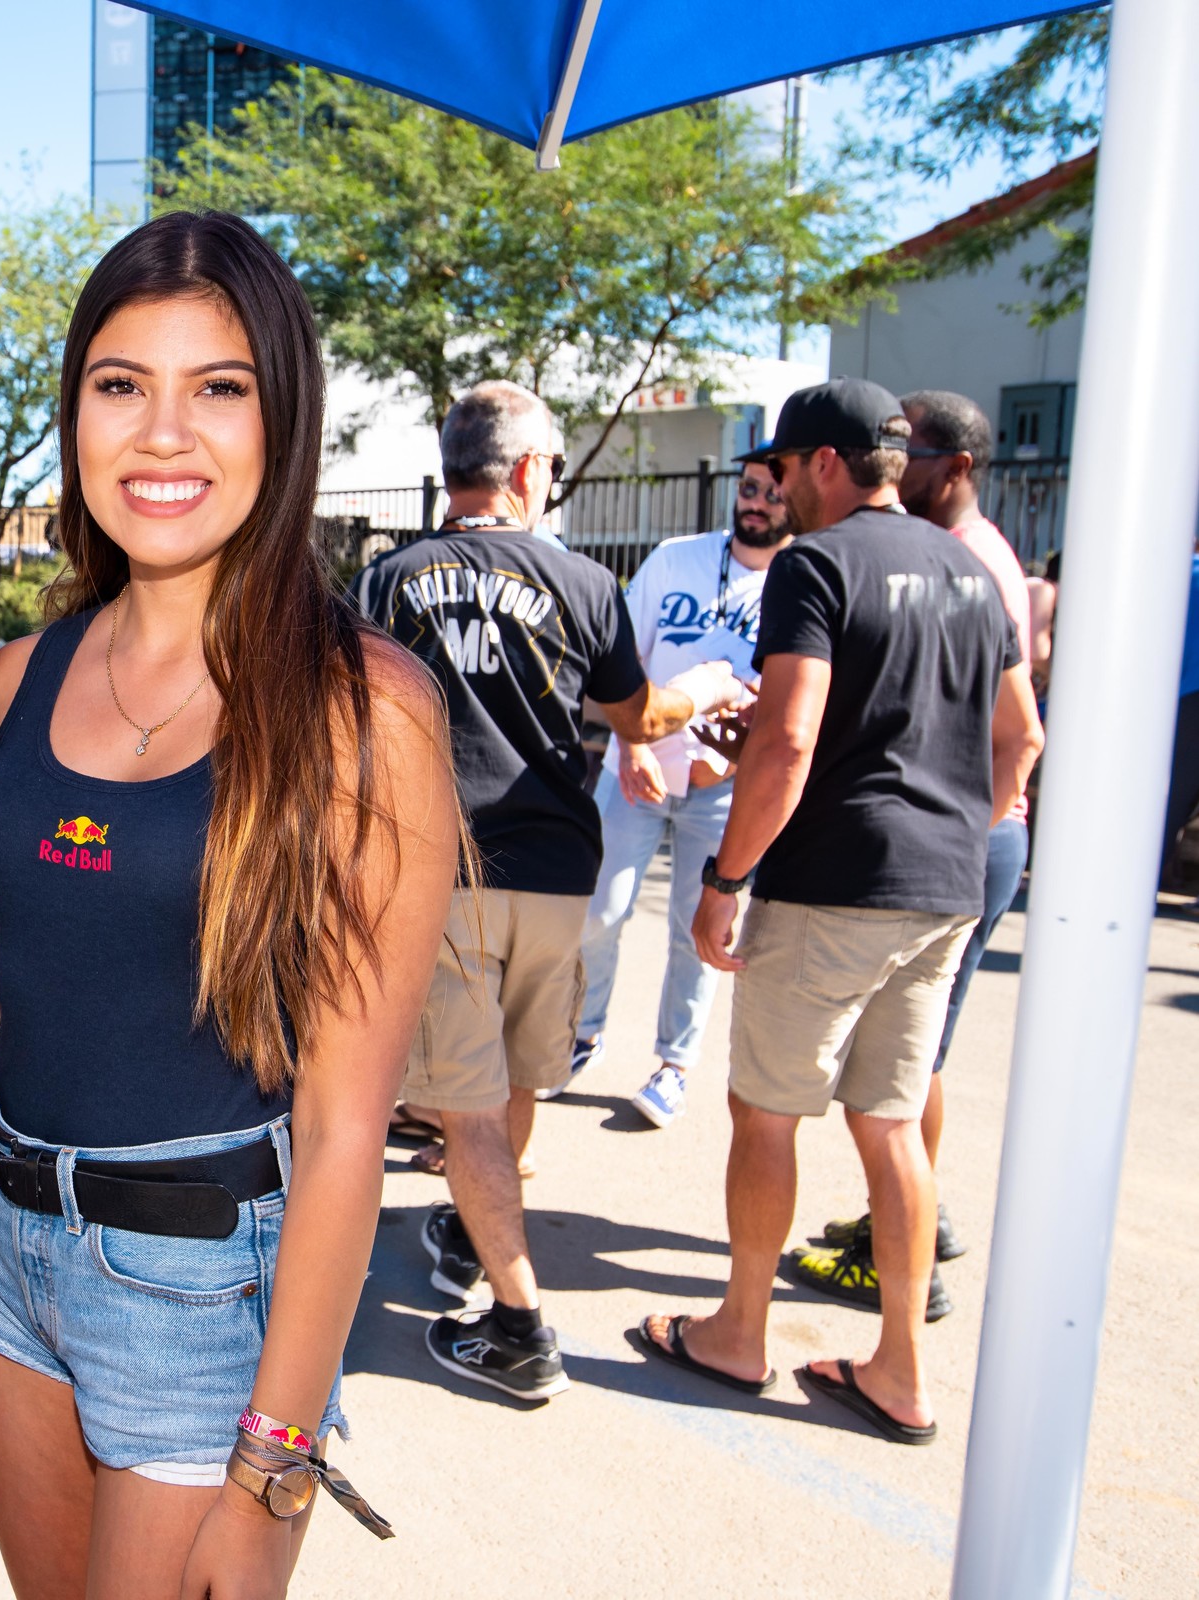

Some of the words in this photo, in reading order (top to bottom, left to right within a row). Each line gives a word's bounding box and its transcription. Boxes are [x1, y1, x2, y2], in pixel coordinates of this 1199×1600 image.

[403, 568, 552, 627] HOLLYWOOD
[445, 617, 500, 675] MC
[38, 839, 78, 868] Red
[79, 848, 112, 871] Bull
